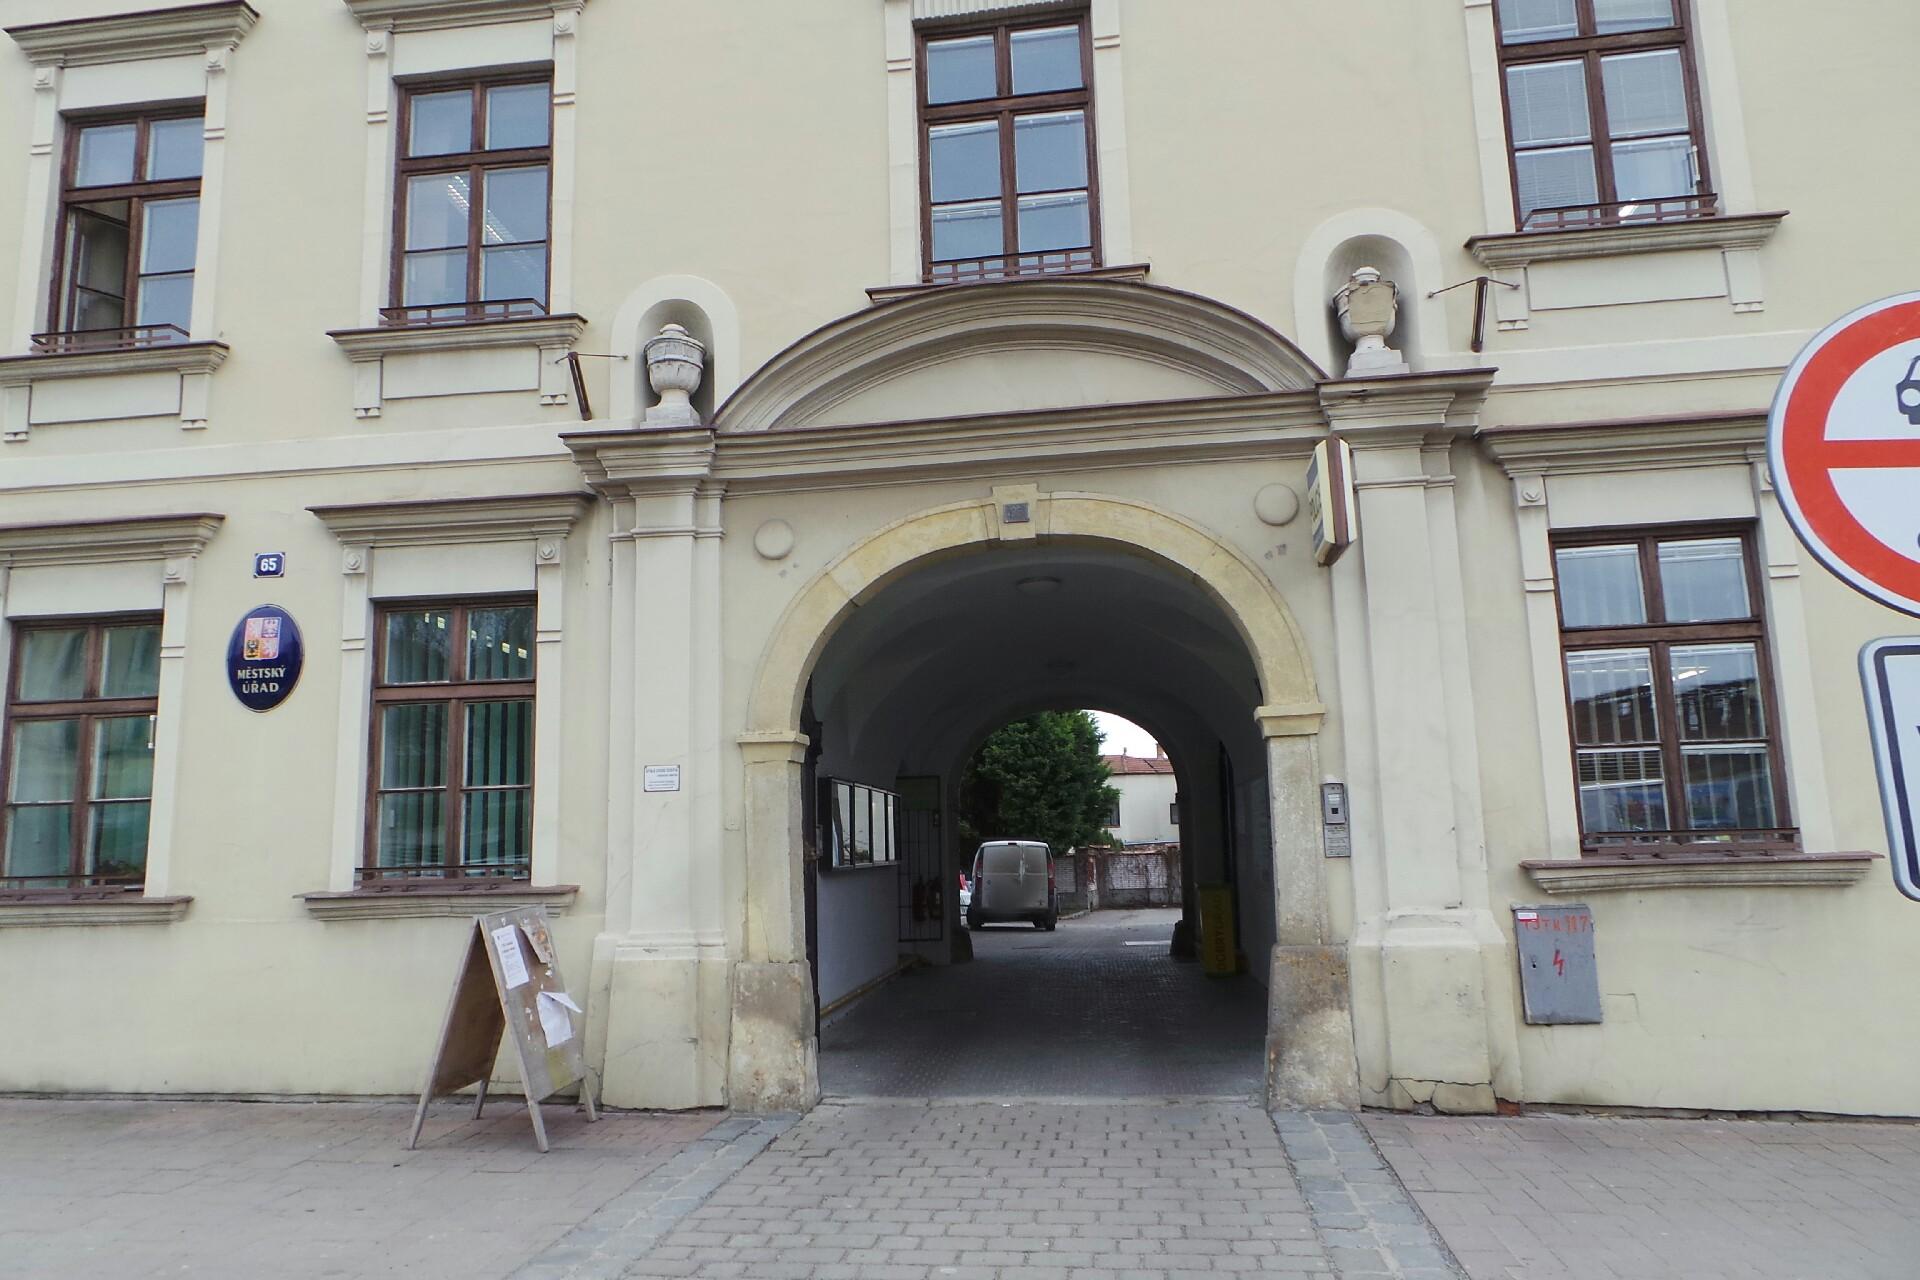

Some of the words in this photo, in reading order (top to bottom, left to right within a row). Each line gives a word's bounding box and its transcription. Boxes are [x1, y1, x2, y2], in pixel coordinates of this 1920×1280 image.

[260, 557, 278, 572] 65
[237, 665, 287, 680] MĚSTSKÝ
[242, 680, 280, 694] ÚŘAD
